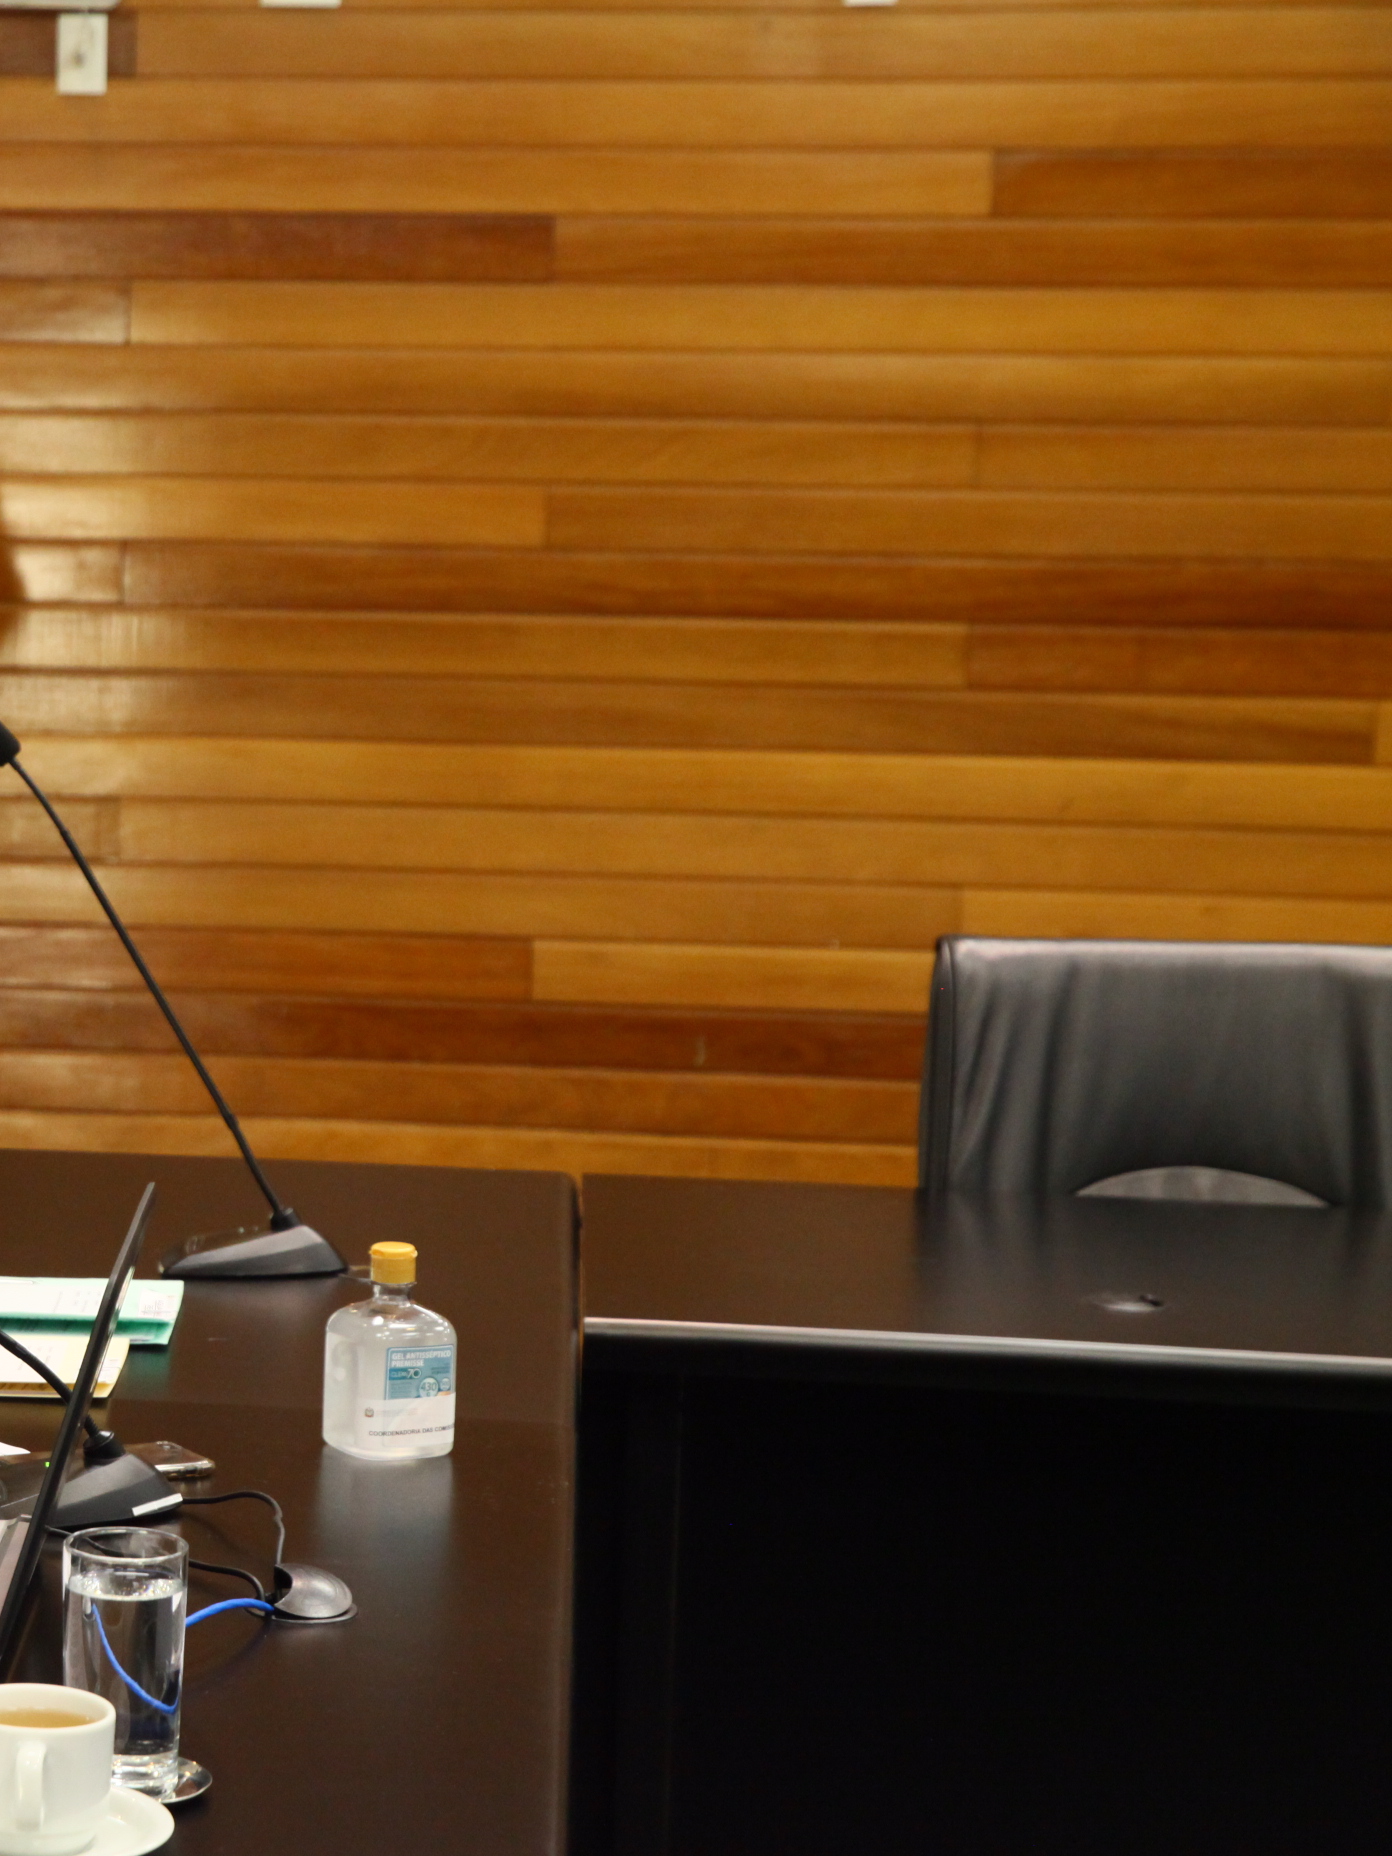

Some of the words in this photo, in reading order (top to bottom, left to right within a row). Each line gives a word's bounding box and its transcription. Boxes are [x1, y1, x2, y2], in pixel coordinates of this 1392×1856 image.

[406, 1350, 452, 1360] ANTISSÉPTICO
[391, 1359, 425, 1368] PREMISSE
[420, 1382, 438, 1391] 430
[368, 1428, 421, 1437] COORDENADORIA
